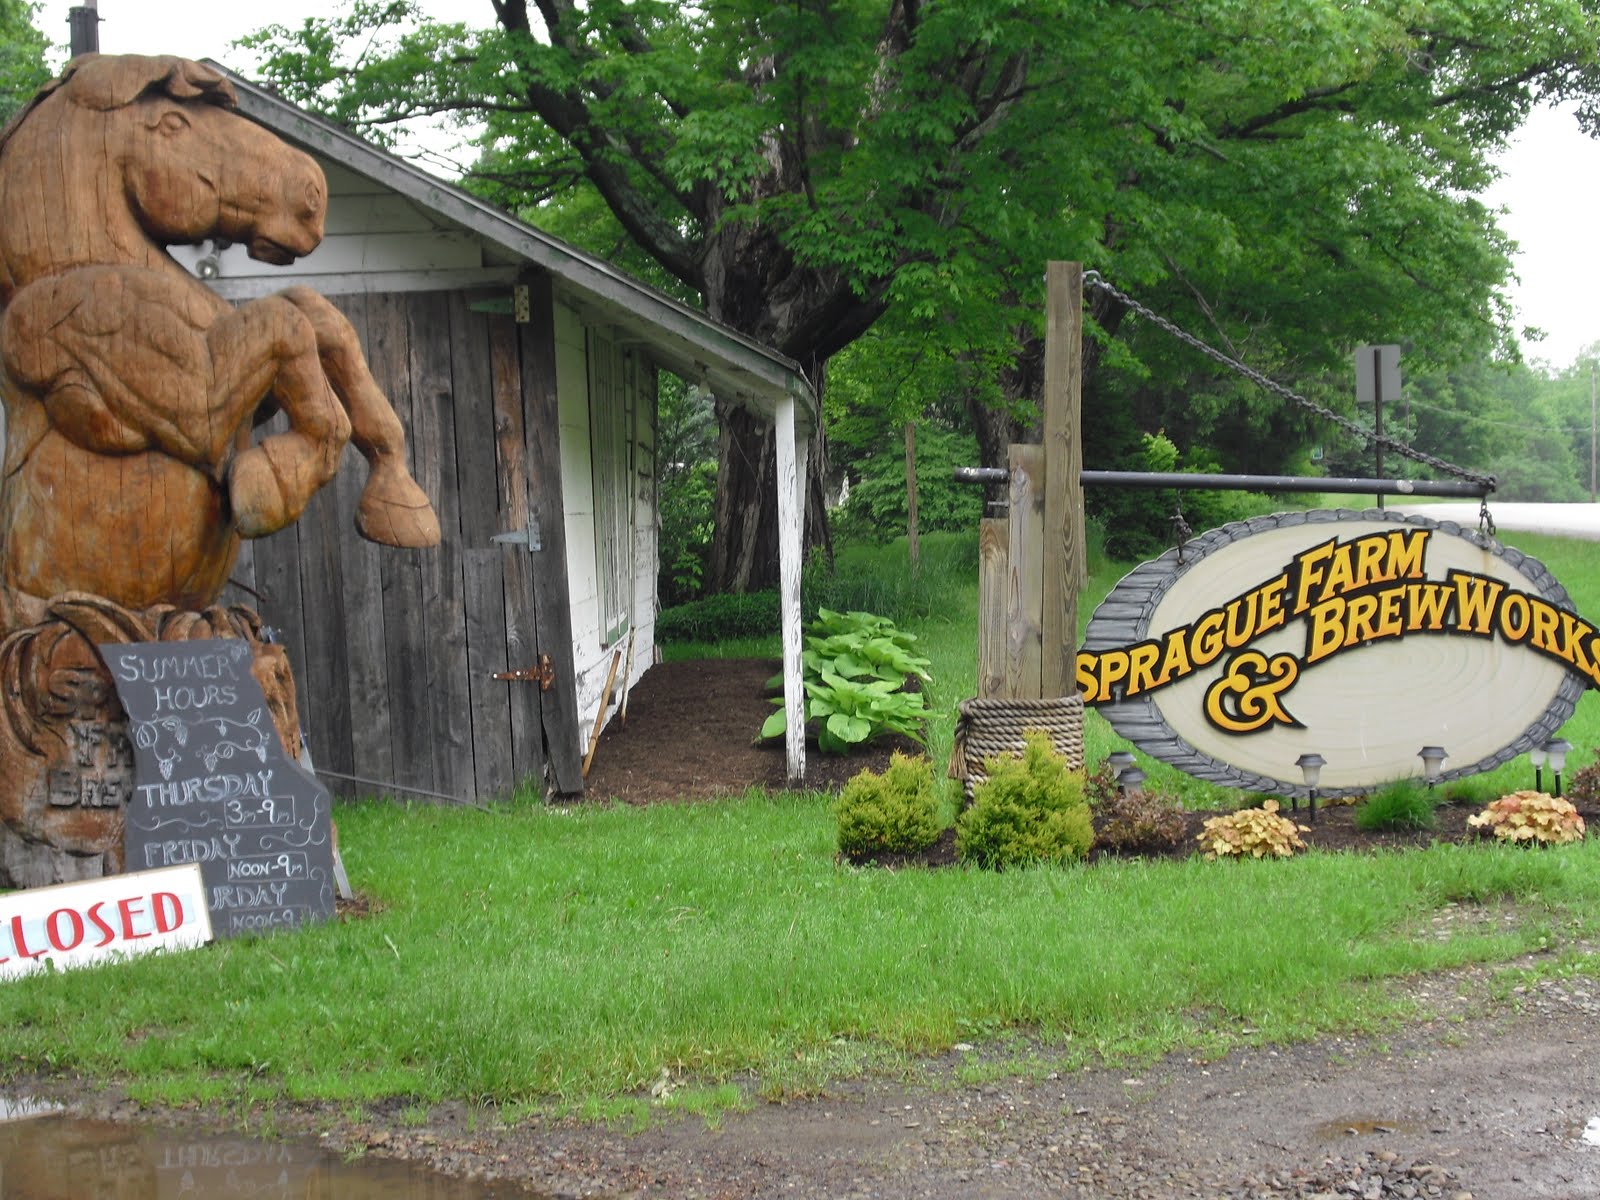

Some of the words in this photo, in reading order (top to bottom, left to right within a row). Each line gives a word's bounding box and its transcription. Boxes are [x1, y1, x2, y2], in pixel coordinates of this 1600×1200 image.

[1076, 573, 1289, 704] SPRAGUE
[1293, 531, 1429, 615] FARM
[118, 655, 239, 683] SUMMER
[154, 684, 238, 711] HOURS
[1207, 652, 1296, 732] &
[137, 769, 273, 808] THURSDAY
[144, 834, 241, 867] FRIDAY
[204, 882, 287, 911] URDAY
[0, 892, 184, 964] LOSED
